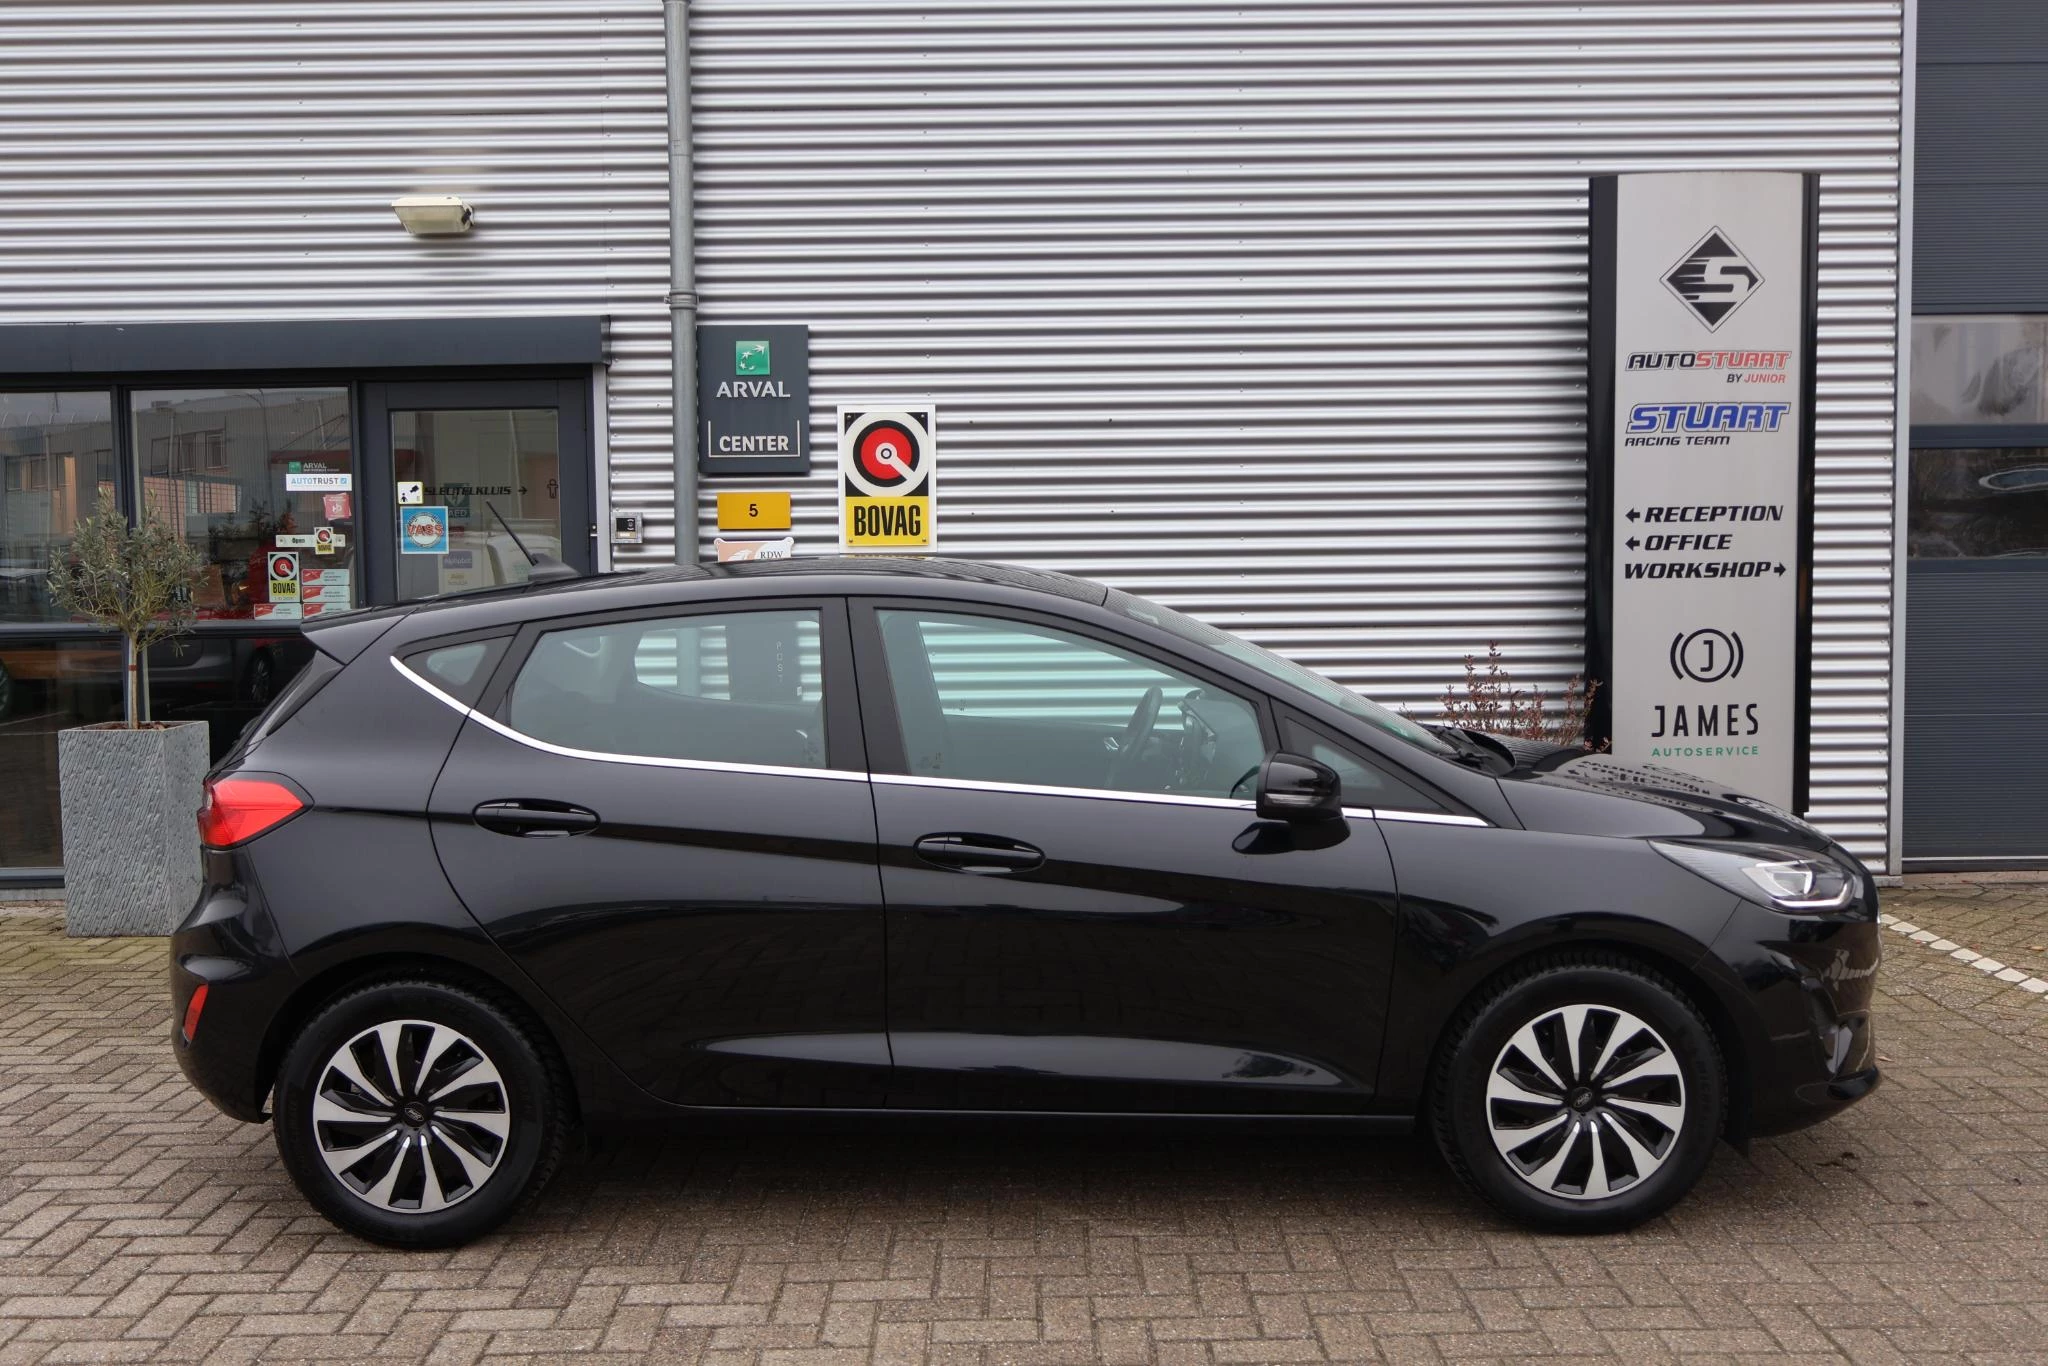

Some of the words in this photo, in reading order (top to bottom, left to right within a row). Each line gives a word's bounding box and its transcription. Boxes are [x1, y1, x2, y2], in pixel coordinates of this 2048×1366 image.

[1626, 350, 1791, 371] AUTOSTUART
[1726, 373, 1742, 383] BY
[1744, 373, 1786, 383] JUNIOR
[716, 381, 791, 399] ARVAL
[1626, 402, 1791, 433] STUART
[719, 434, 789, 453] CENTER
[1625, 436, 1681, 447] RACING
[1685, 436, 1730, 446] TEAM
[291, 477, 339, 485] AUTOTRUST
[424, 485, 512, 496] SLEUTELKLUIS
[748, 503, 759, 518] 5
[1644, 505, 1784, 523] RECEPTION
[853, 505, 921, 537] BOVAG
[1644, 534, 1733, 551] OFFICE
[759, 550, 784, 559] RDW
[1624, 561, 1772, 579] WORKSHOP
[272, 582, 296, 594] BOVAG
[1651, 703, 1759, 738] JAMES
[1651, 746, 1759, 758] AUTOSERVICE
